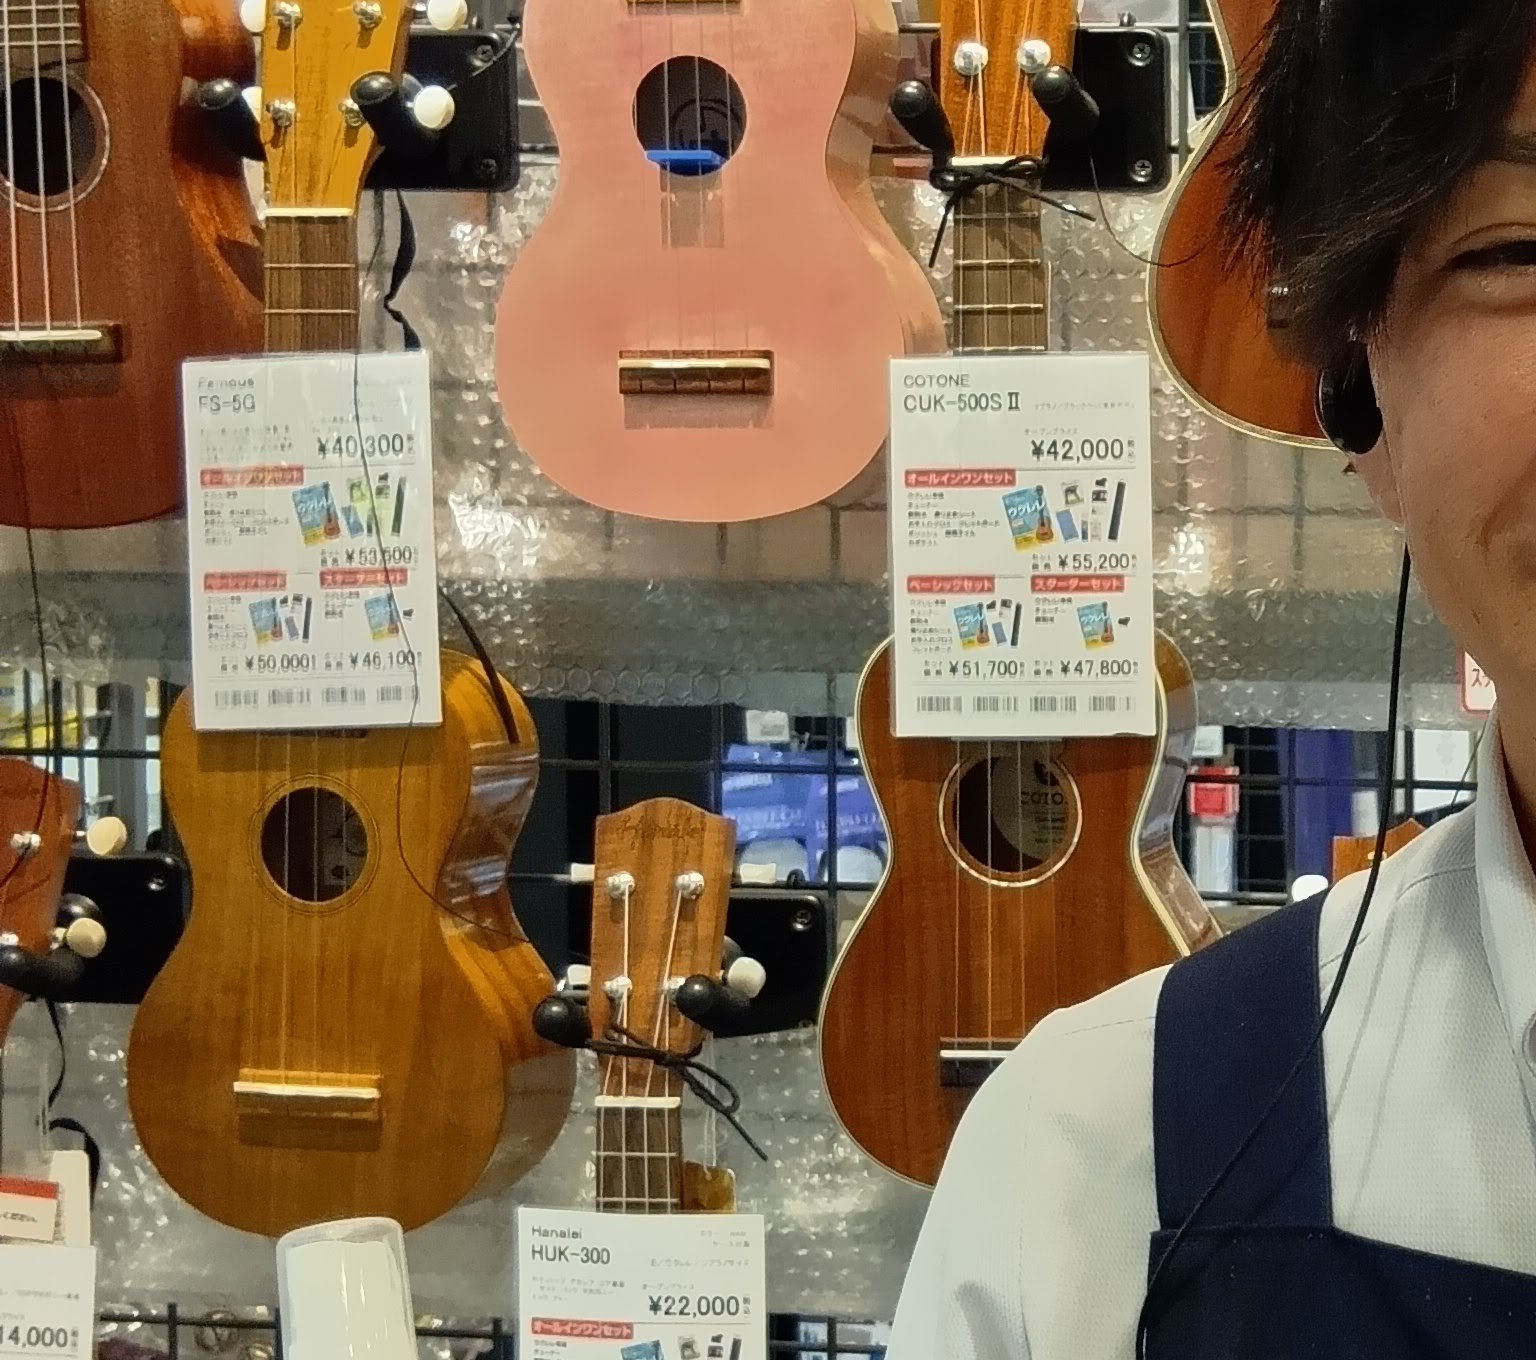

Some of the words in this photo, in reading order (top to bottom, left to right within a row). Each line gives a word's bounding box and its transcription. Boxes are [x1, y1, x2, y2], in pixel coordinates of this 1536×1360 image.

[904, 374, 970, 387] COTONE
[317, 434, 404, 459] ¥40300
[1031, 439, 1124, 463] ¥42,000
[907, 472, 1013, 485] オールインワンセット
[1058, 553, 1130, 572] ¥55,200
[909, 578, 992, 591] ベーシックセット
[1034, 578, 1122, 590] スターターセット
[949, 660, 1018, 680] ¥51,700
[1060, 659, 1131, 680] ¥47,800
[532, 1226, 582, 1240] Hanalei
[532, 1245, 610, 1265] HUK-300
[649, 1295, 739, 1317] ¥22,000
[533, 1319, 632, 1336] オールインワンセット
